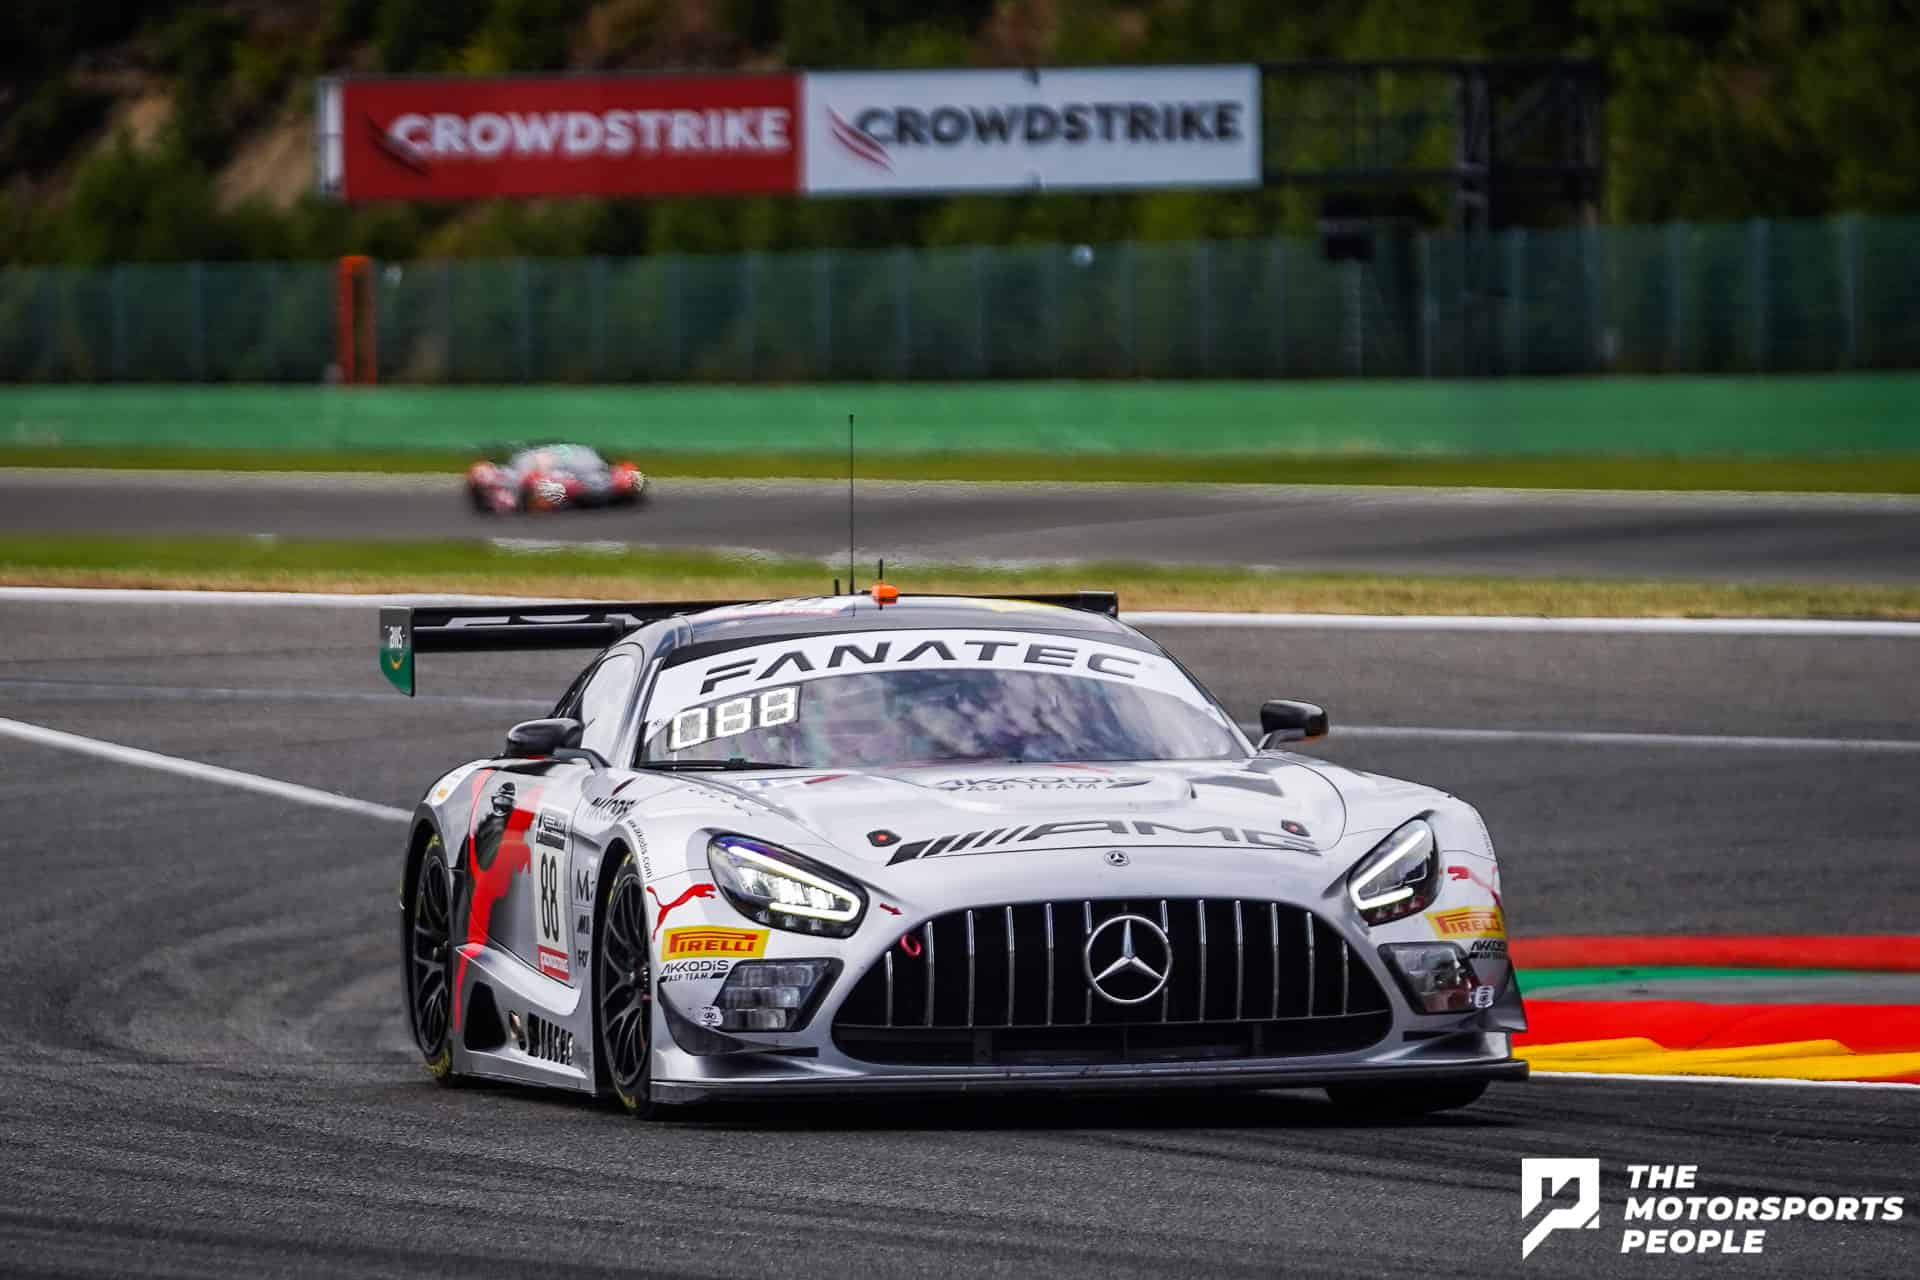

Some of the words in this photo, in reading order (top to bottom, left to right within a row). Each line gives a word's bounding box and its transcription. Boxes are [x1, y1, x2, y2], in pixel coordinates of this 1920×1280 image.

[390, 108, 790, 155] CROWDSTRIKE
[856, 101, 1244, 145] CROWDSTRIKE
[700, 640, 1148, 695] FANATEC
[669, 686, 797, 751] 088
[1024, 783, 1098, 791] TEAM
[1018, 820, 1322, 857] AMG
[540, 852, 560, 943] 88
[668, 930, 759, 955] PIRELLI
[685, 972, 710, 982] TEAM
